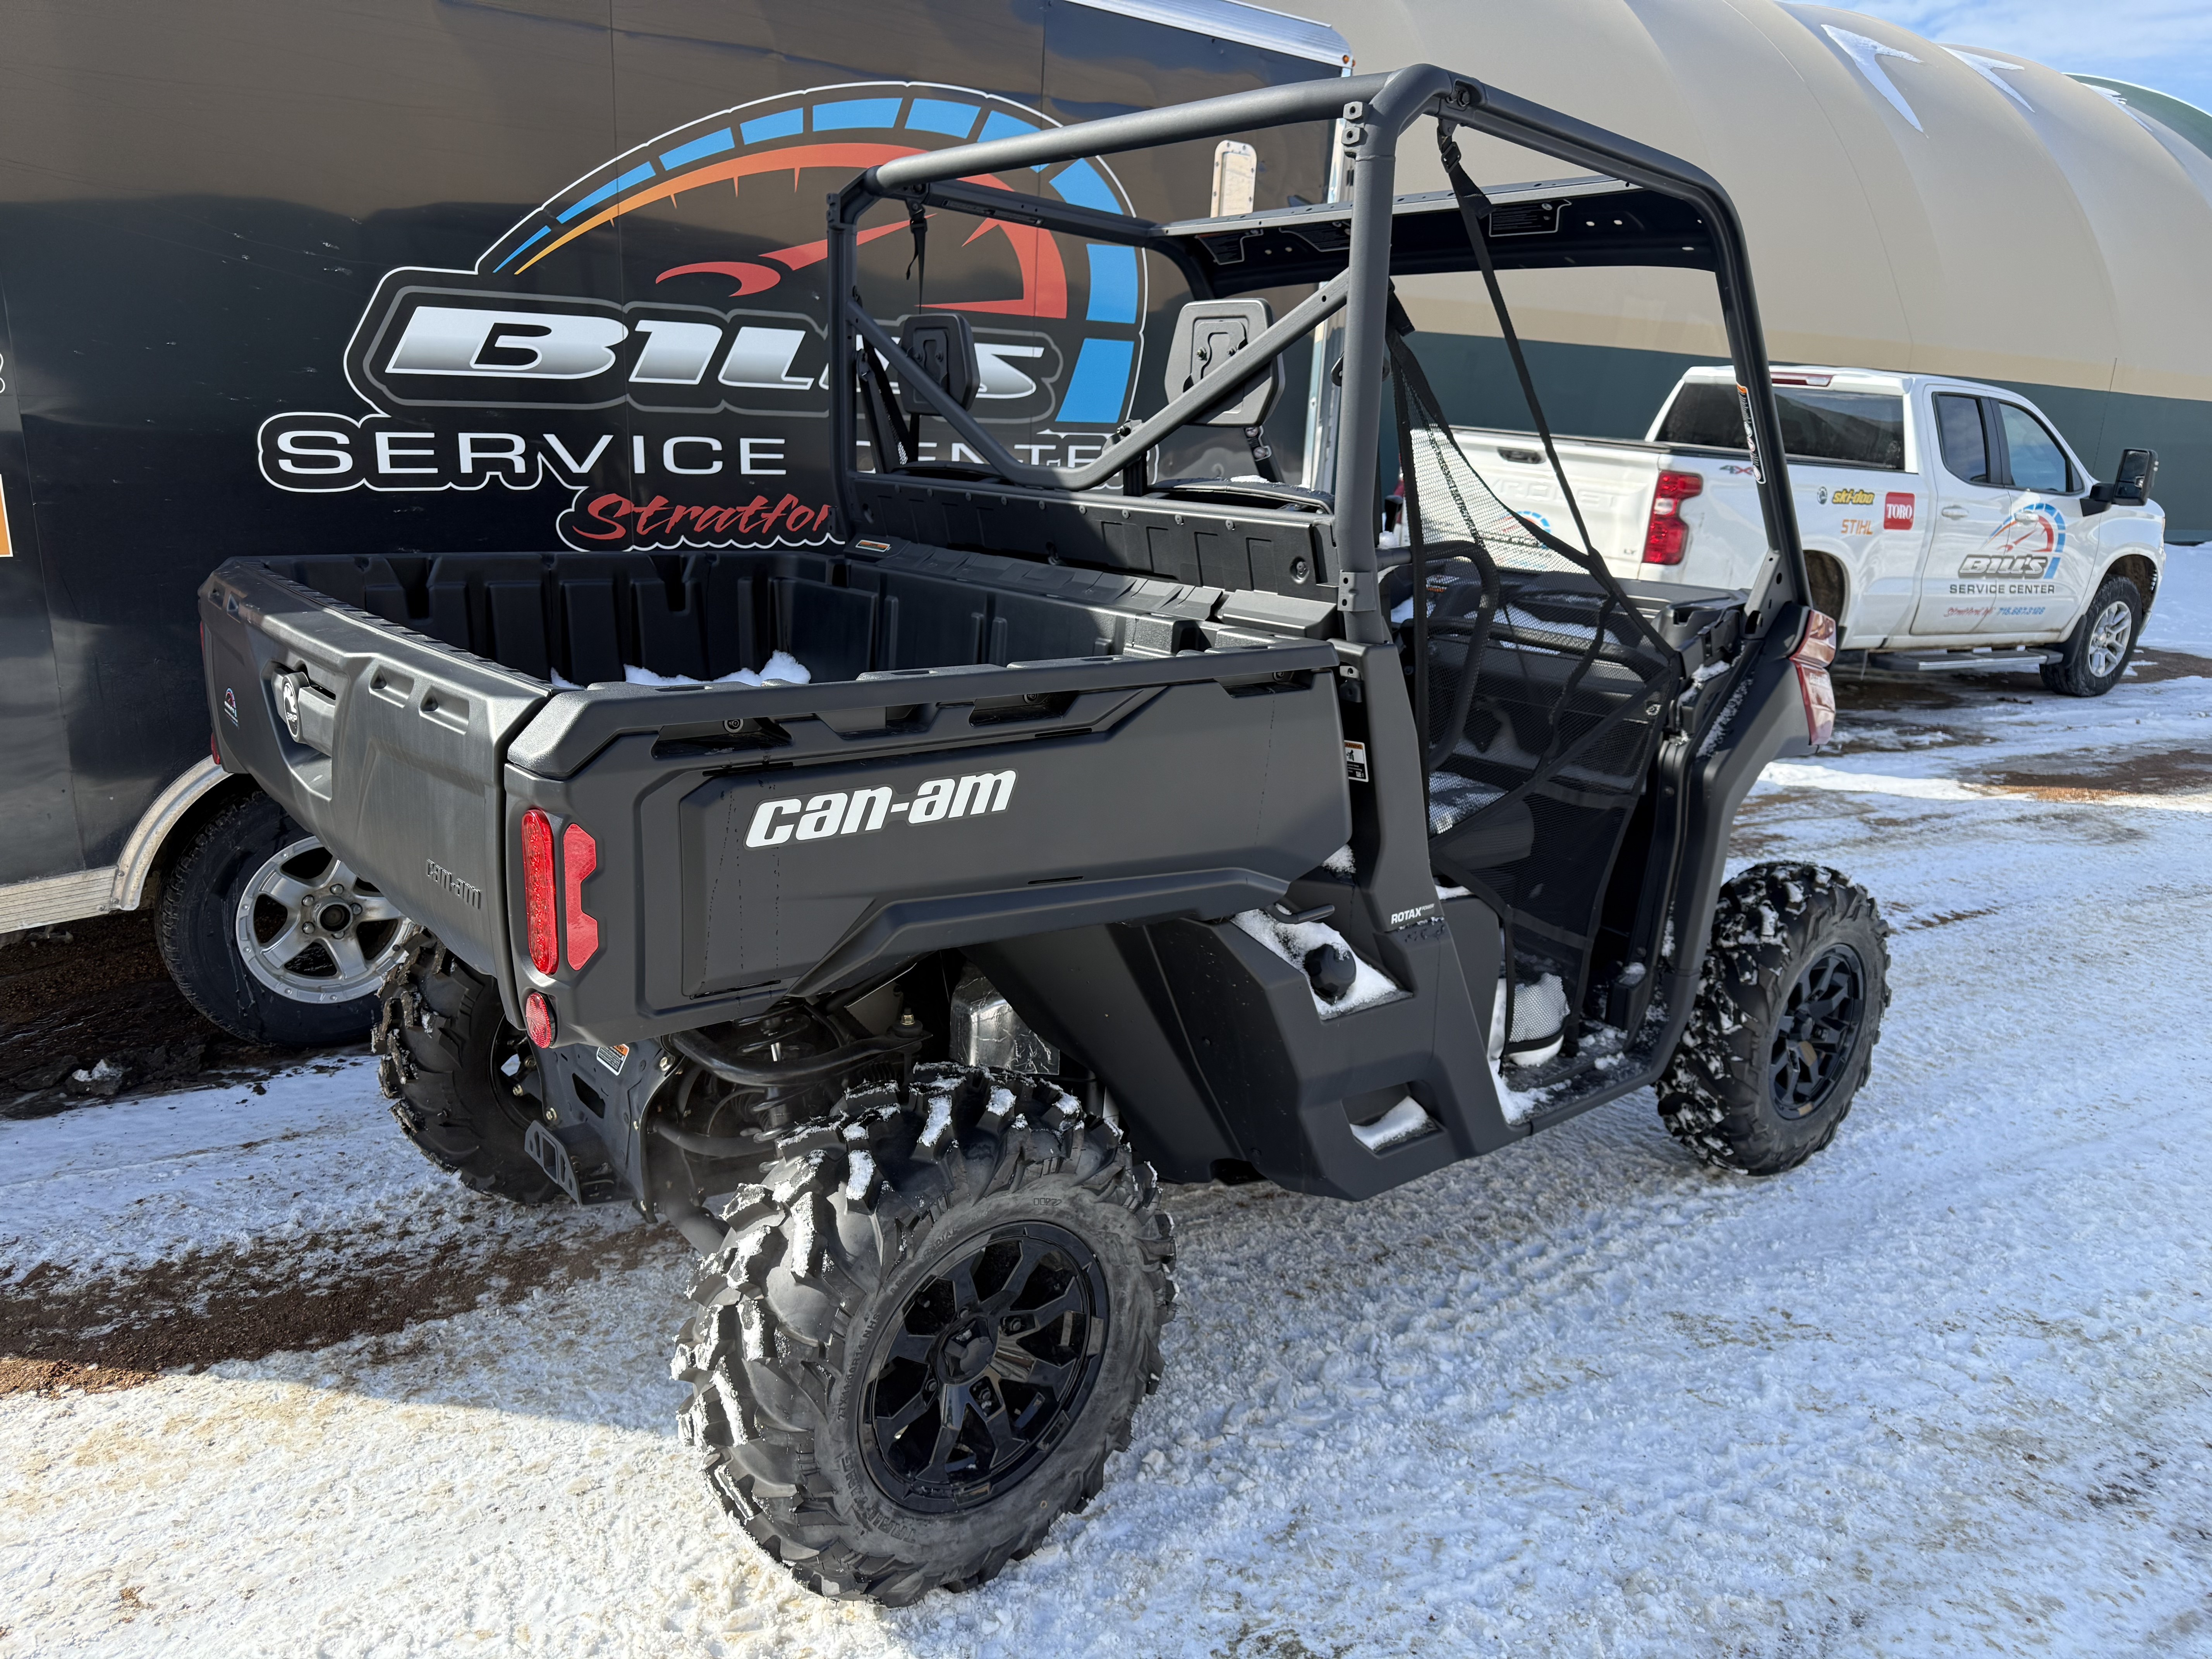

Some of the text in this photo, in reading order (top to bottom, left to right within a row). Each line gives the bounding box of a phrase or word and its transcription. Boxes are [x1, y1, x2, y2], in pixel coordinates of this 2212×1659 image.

[385, 306, 1045, 399] BILS
[277, 430, 787, 475] SERVICE
[1719, 465, 1753, 476] 4X
[1832, 489, 1875, 505] ski-doo
[1887, 504, 1913, 519] TORO
[1841, 519, 1874, 535] STIHL
[1949, 584, 2055, 594] SERVICE CENTER
[745, 770, 1017, 848] can-am
[1391, 907, 1422, 924] ROTAX
